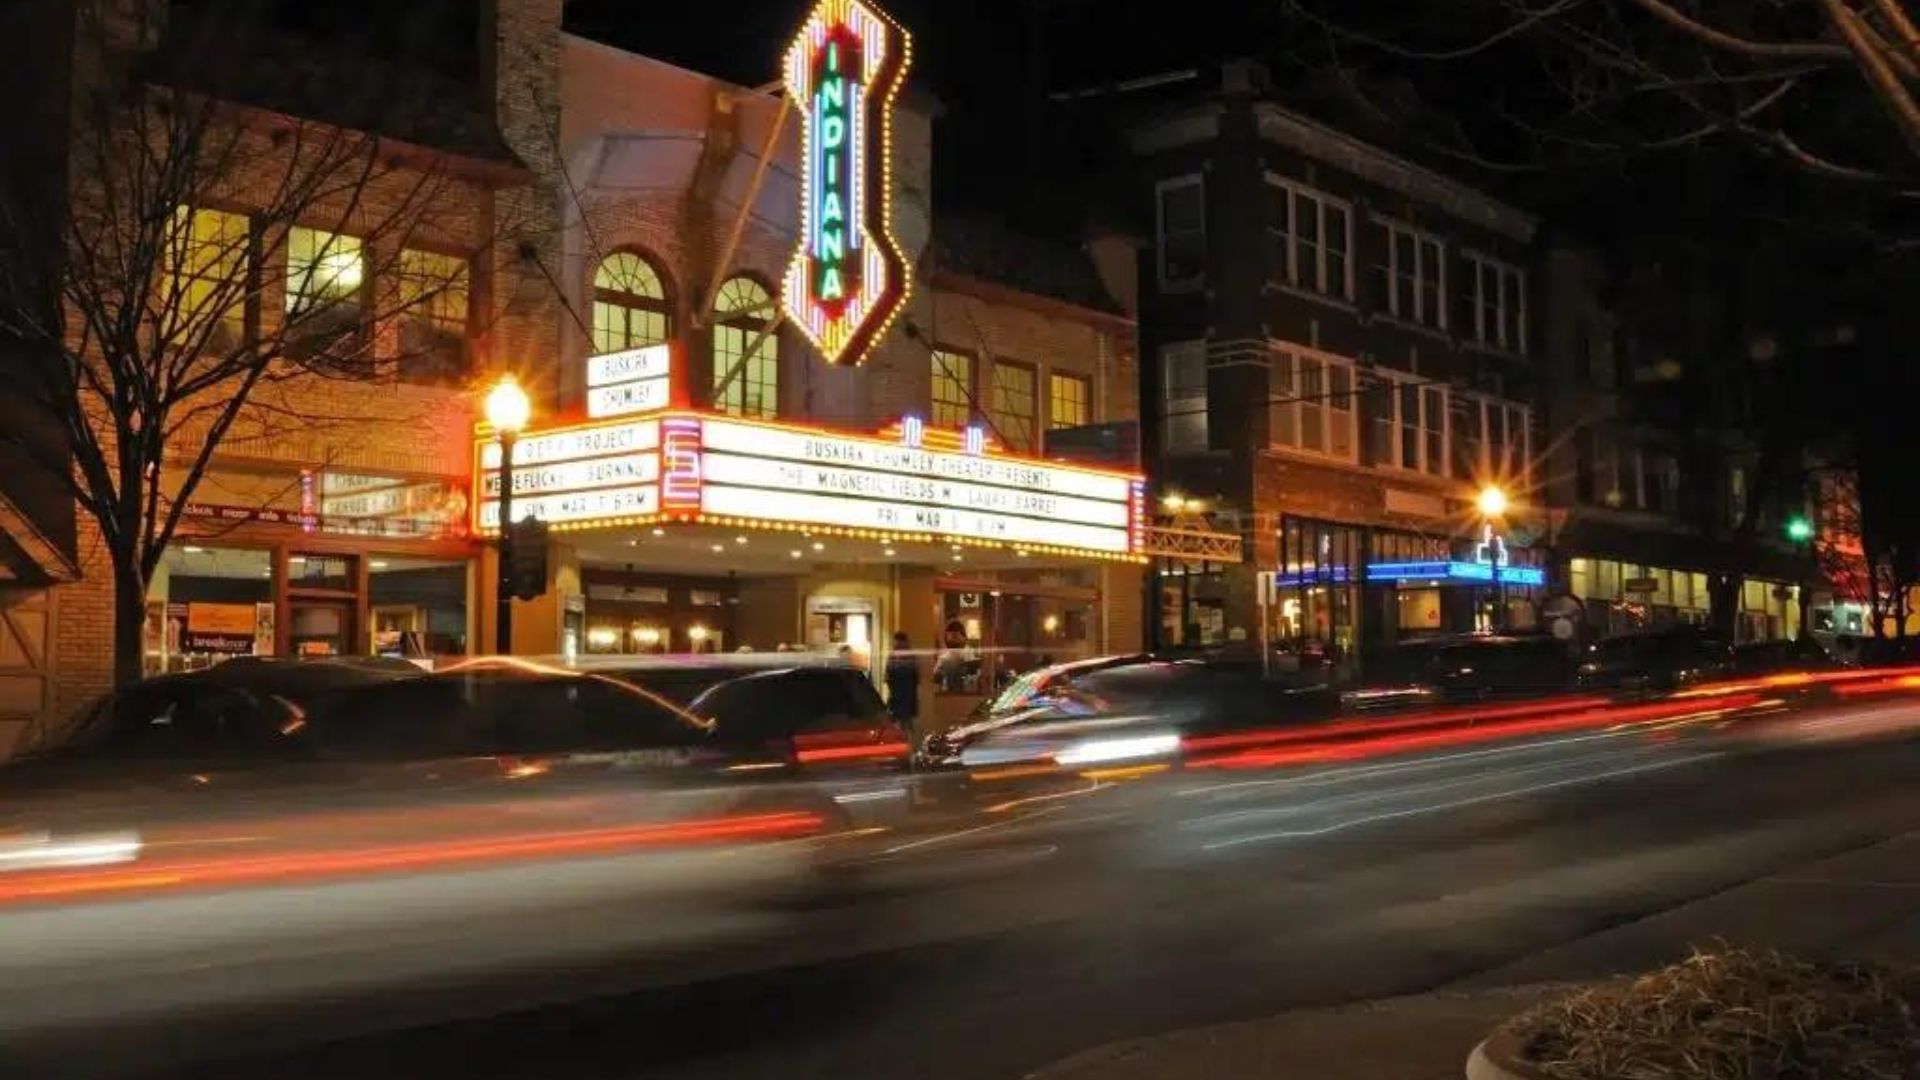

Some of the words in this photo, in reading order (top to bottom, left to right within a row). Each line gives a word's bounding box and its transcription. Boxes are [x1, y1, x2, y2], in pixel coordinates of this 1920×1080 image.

[820, 41, 842, 301] INDIANA
[805, 440, 863, 461] BUSKIRK
[915, 510, 940, 529] MAR
